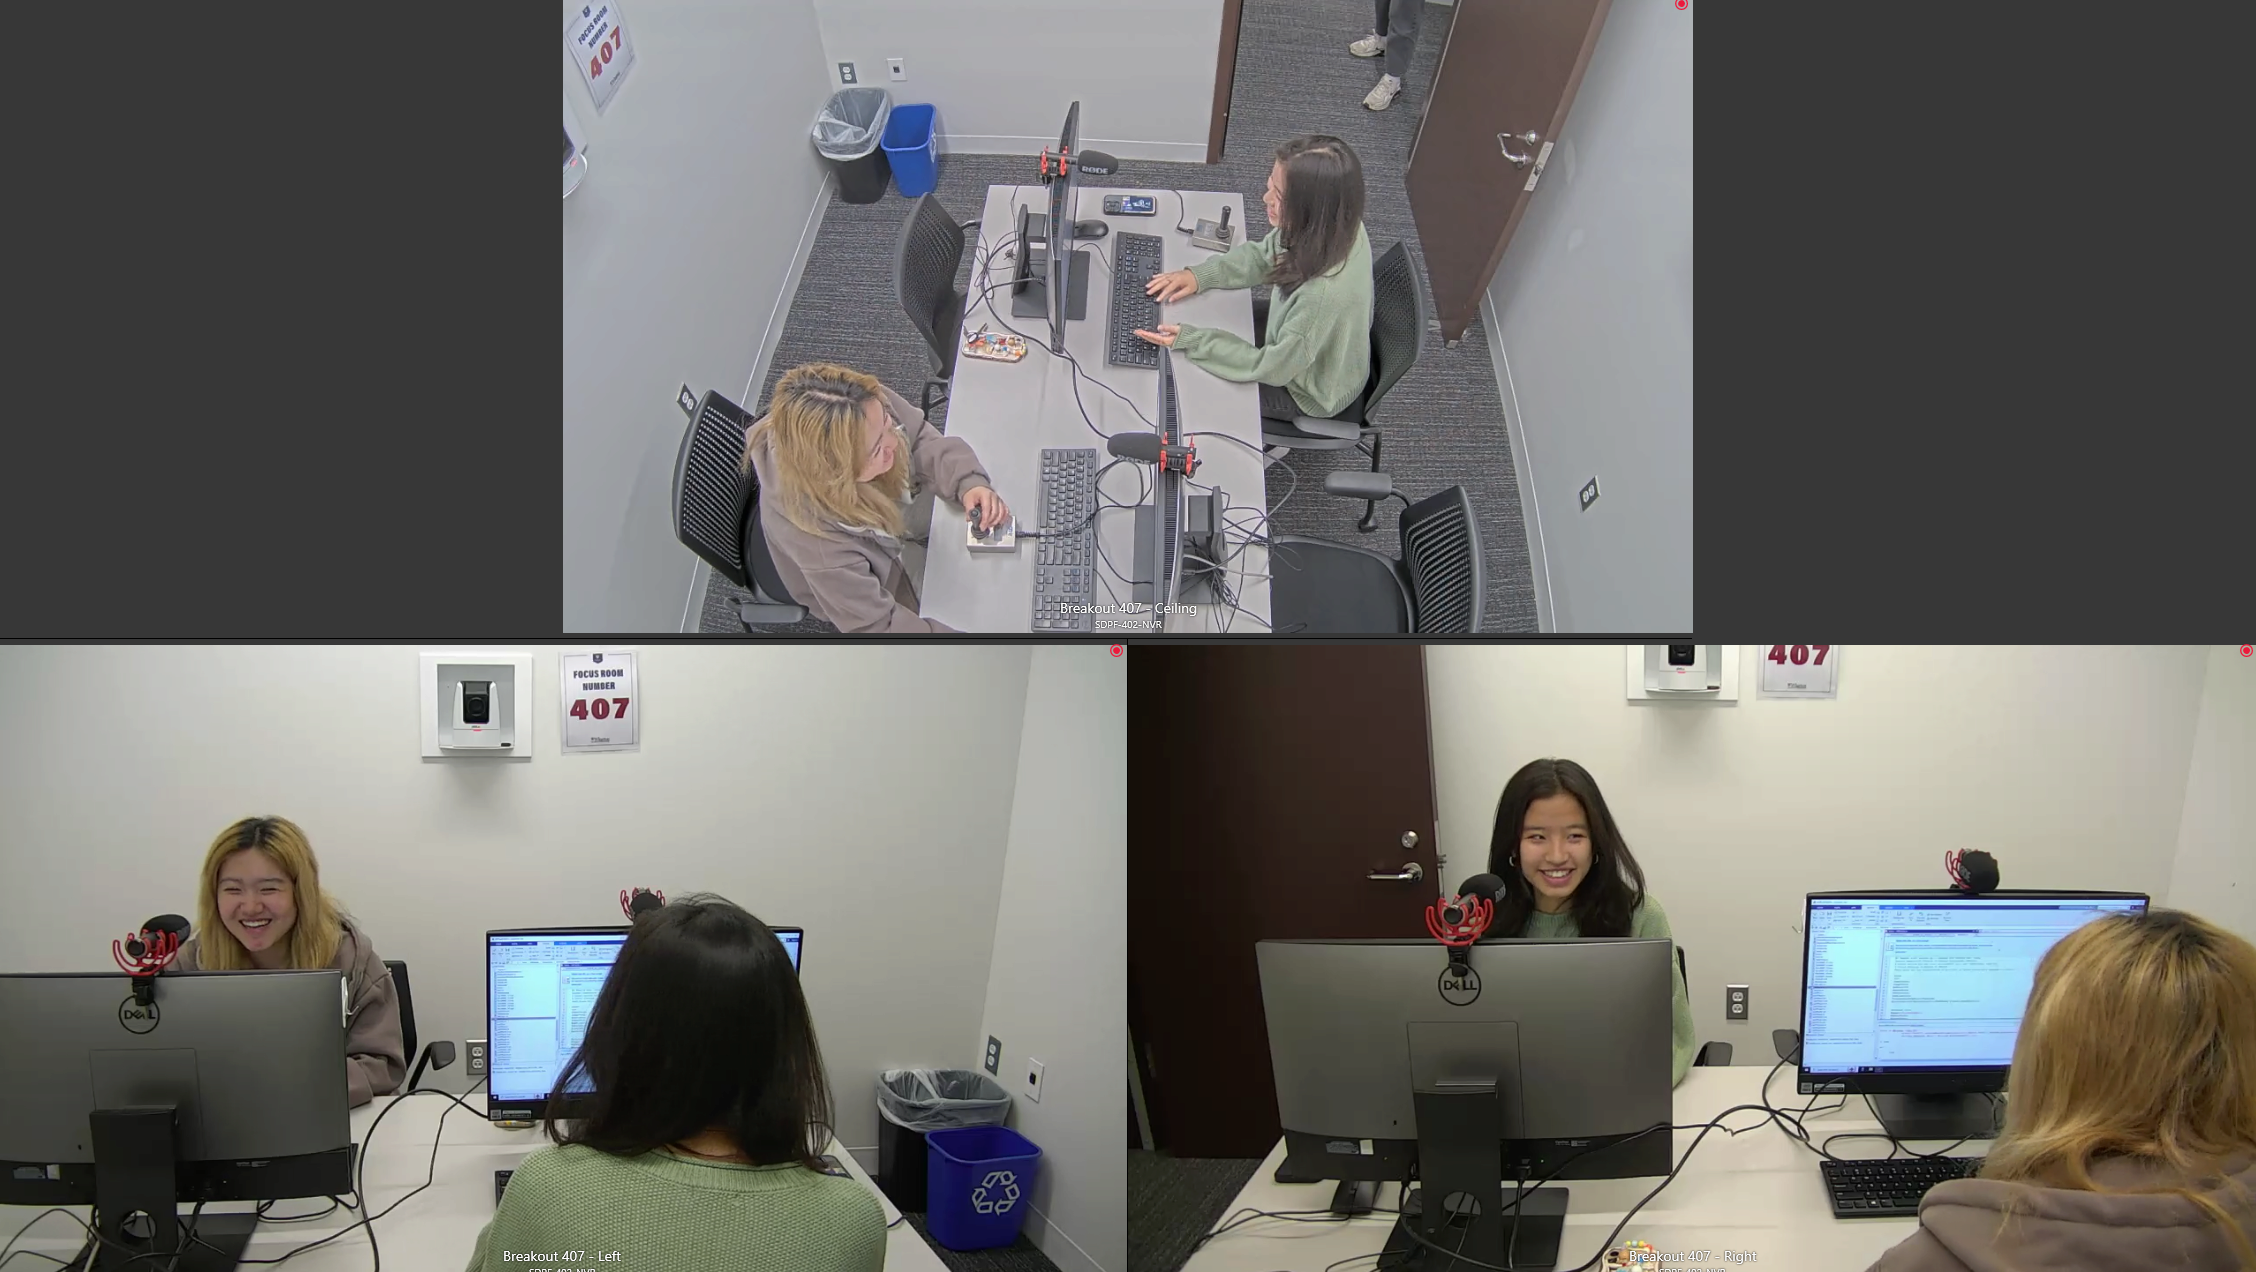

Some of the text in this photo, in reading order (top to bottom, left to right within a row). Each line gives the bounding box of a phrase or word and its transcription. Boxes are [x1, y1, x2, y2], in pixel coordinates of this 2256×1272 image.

[577, 5, 608, 45] FOCUS ROOM
[588, 21, 609, 49] NUMBER
[590, 25, 622, 80] 407
[1767, 644, 1831, 666] 407
[573, 669, 624, 679] FOCUS ROOM
[582, 681, 616, 691] NUMBER
[569, 697, 630, 720] 407
